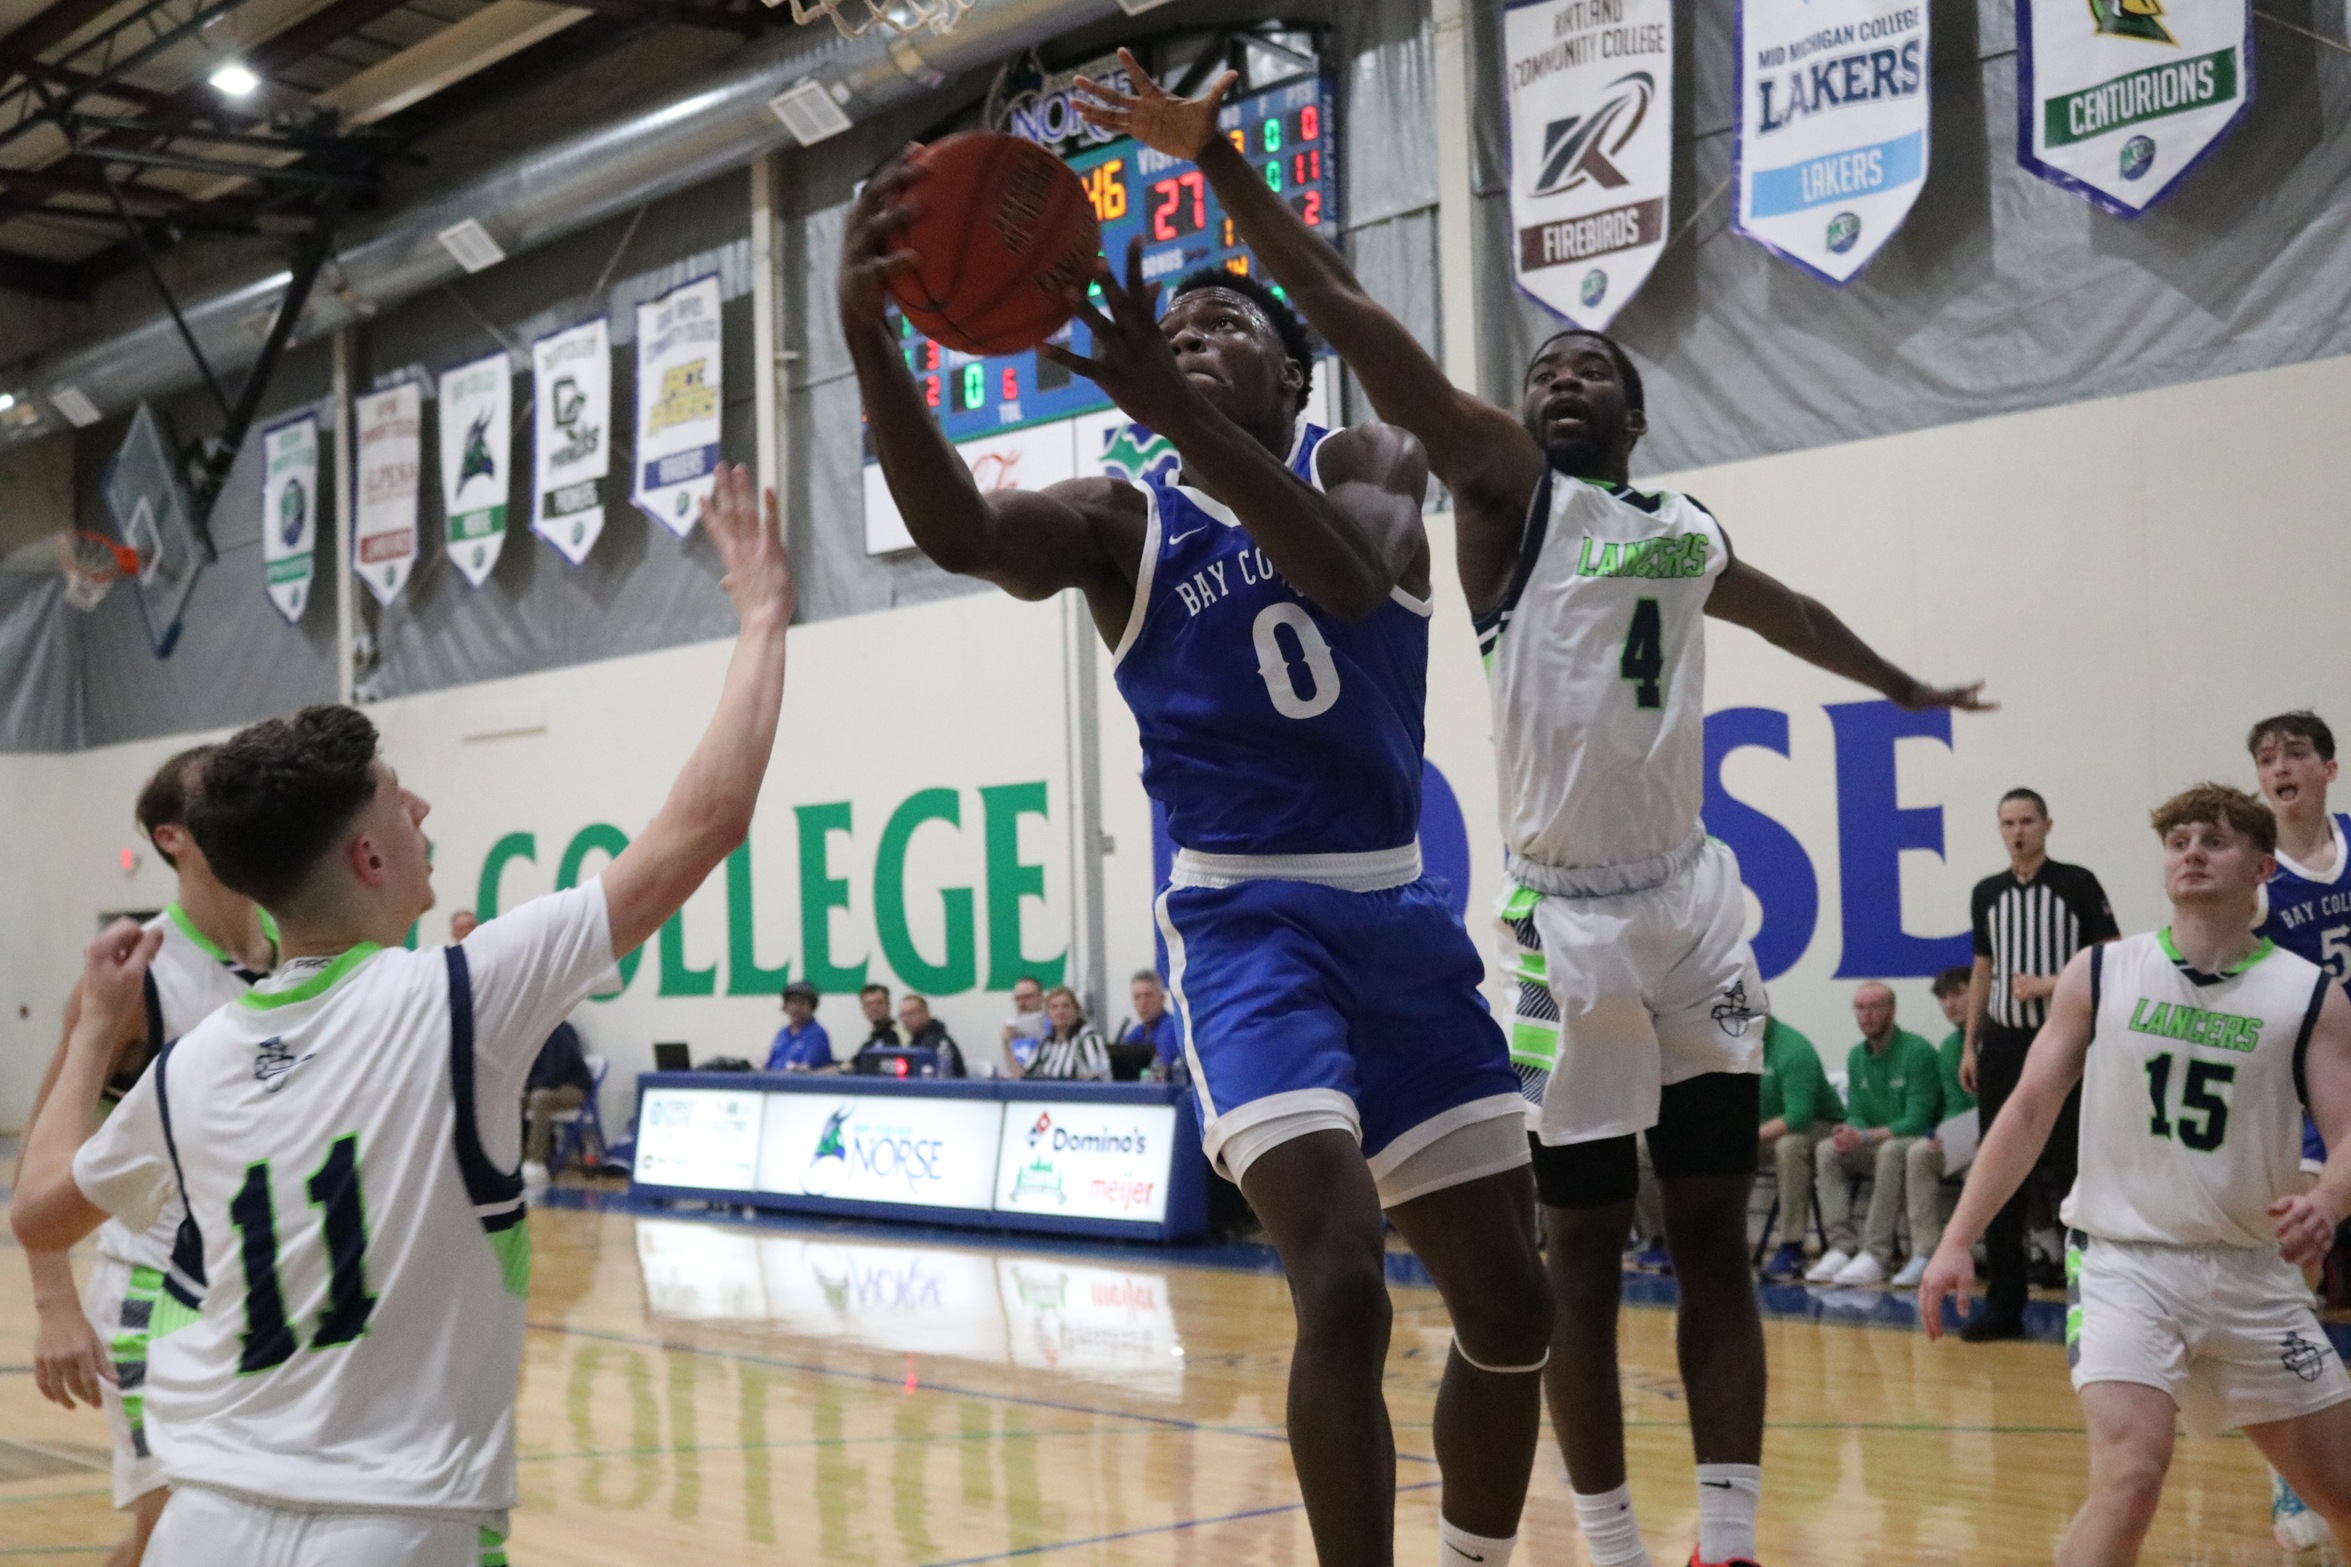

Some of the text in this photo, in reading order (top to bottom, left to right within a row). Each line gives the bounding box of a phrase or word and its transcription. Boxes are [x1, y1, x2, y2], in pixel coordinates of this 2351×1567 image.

[1602, 24, 1665, 59] COLLEGE
[1758, 47, 1786, 69] MID
[1859, 6, 1920, 42] COLLEGE
[1756, 36, 1923, 134] LAKERS
[2068, 58, 2215, 137] CENTURIONS
[1263, 118, 1282, 153] 0
[1301, 104, 1319, 142] 0
[1080, 158, 1127, 221] 46
[1295, 149, 1320, 185] 11
[1802, 149, 1884, 203] LAKERS
[1154, 170, 1206, 242] 27
[1303, 190, 1321, 226] 2
[1543, 208, 1640, 262] FIREBIRDS
[926, 375, 942, 408] 2
[964, 362, 985, 410] 0
[1175, 560, 1229, 617] BAY
[1252, 602, 1340, 719] 0
[1619, 597, 1664, 711] 4
[2128, 997, 2265, 1053] LANCERS
[2144, 1052, 2237, 1154] 15
[852, 1137, 943, 1193] NORSE
[1053, 1127, 1147, 1154] Domino's
[1089, 1173, 1155, 1211] meijer
[229, 1130, 379, 1377] 11
